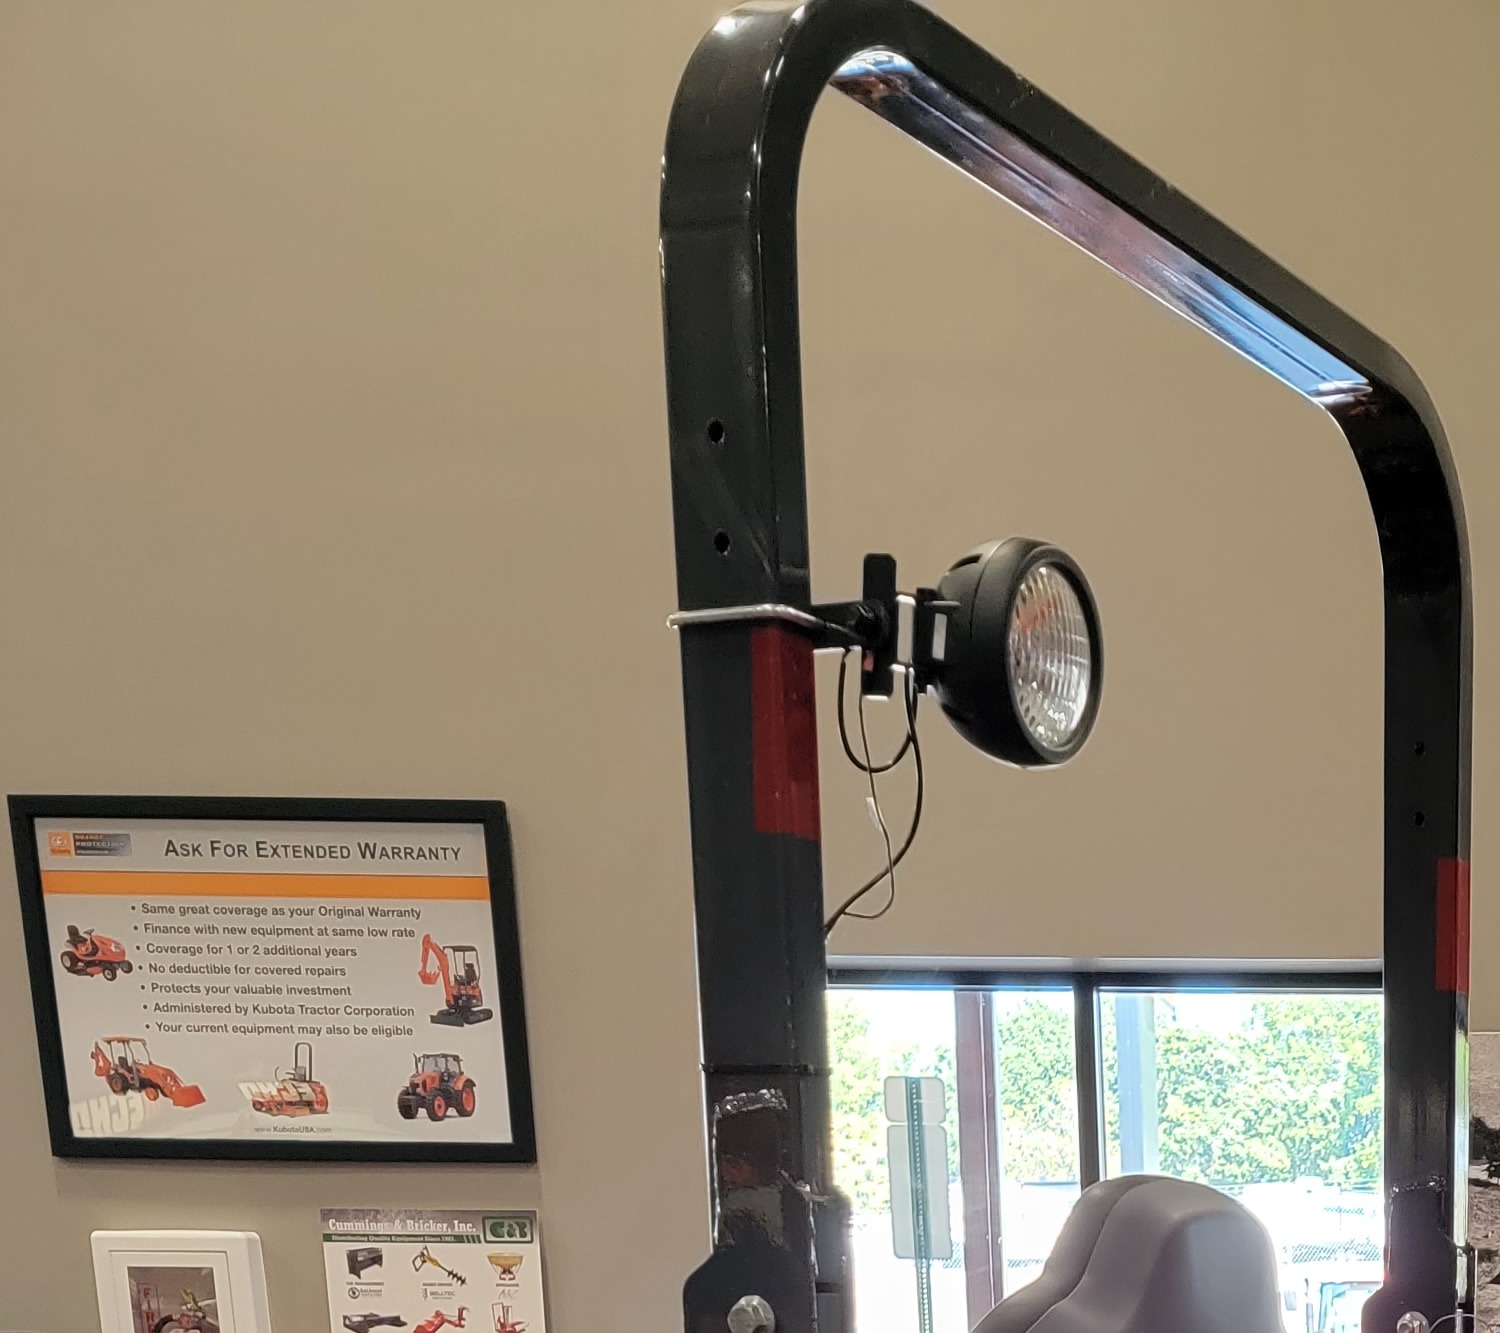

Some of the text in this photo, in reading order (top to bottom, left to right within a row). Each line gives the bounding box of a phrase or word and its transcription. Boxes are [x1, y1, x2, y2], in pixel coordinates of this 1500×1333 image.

[141, 903, 421, 919] Same great coverage as your Original Warranty
[144, 923, 416, 938] Finance with new equipment at same low rate
[146, 943, 358, 958] Coverage for 1 or 2 additional years
[149, 963, 347, 978] No deductible for covered repairs
[150, 982, 352, 996] Protects your valuable investment
[153, 1002, 415, 1018] Administered by Kubota Tractor Corporation
[155, 1022, 413, 1038] Your current equipment may also be eligible
[328, 1219, 476, 1233] Cummings & Bricker, Inc.
